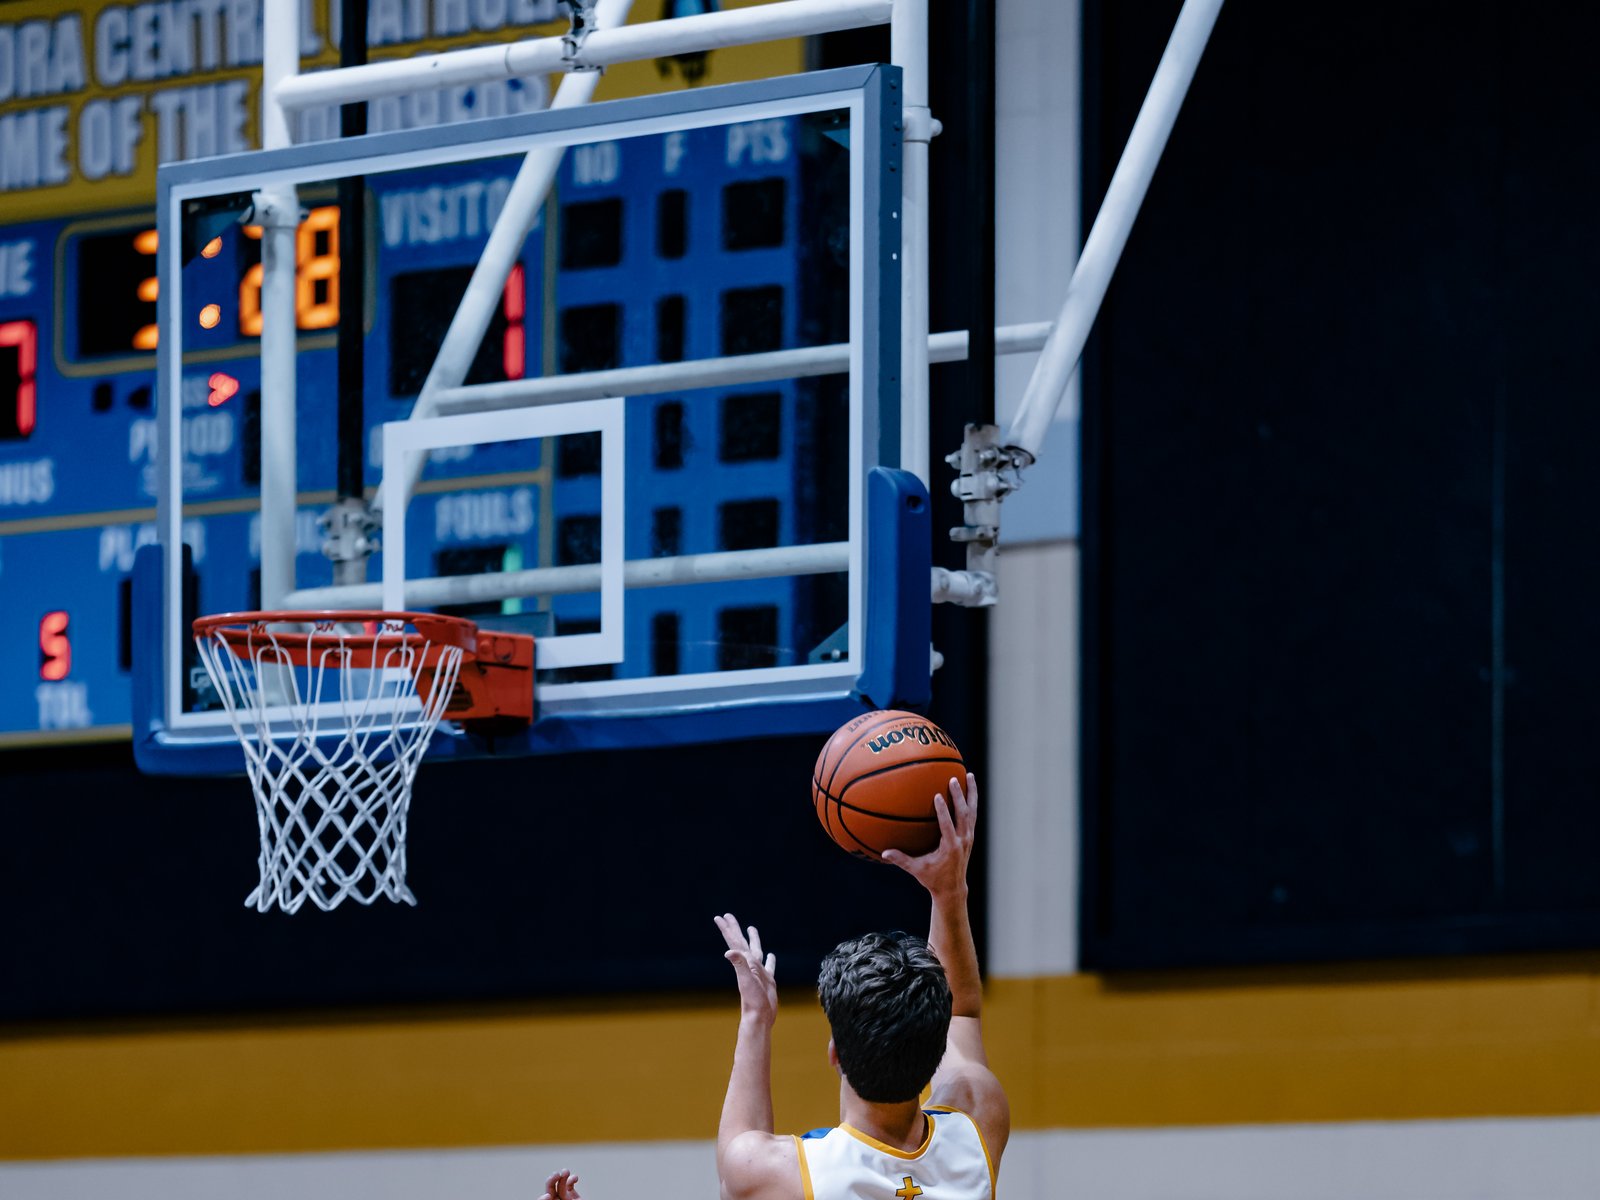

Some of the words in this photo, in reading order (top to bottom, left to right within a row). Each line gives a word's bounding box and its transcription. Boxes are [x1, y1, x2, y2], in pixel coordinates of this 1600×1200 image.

[80, 93, 143, 179] OF
[152, 79, 250, 163] THE
[726, 118, 787, 165] PTS
[40, 610, 72, 681] 5
